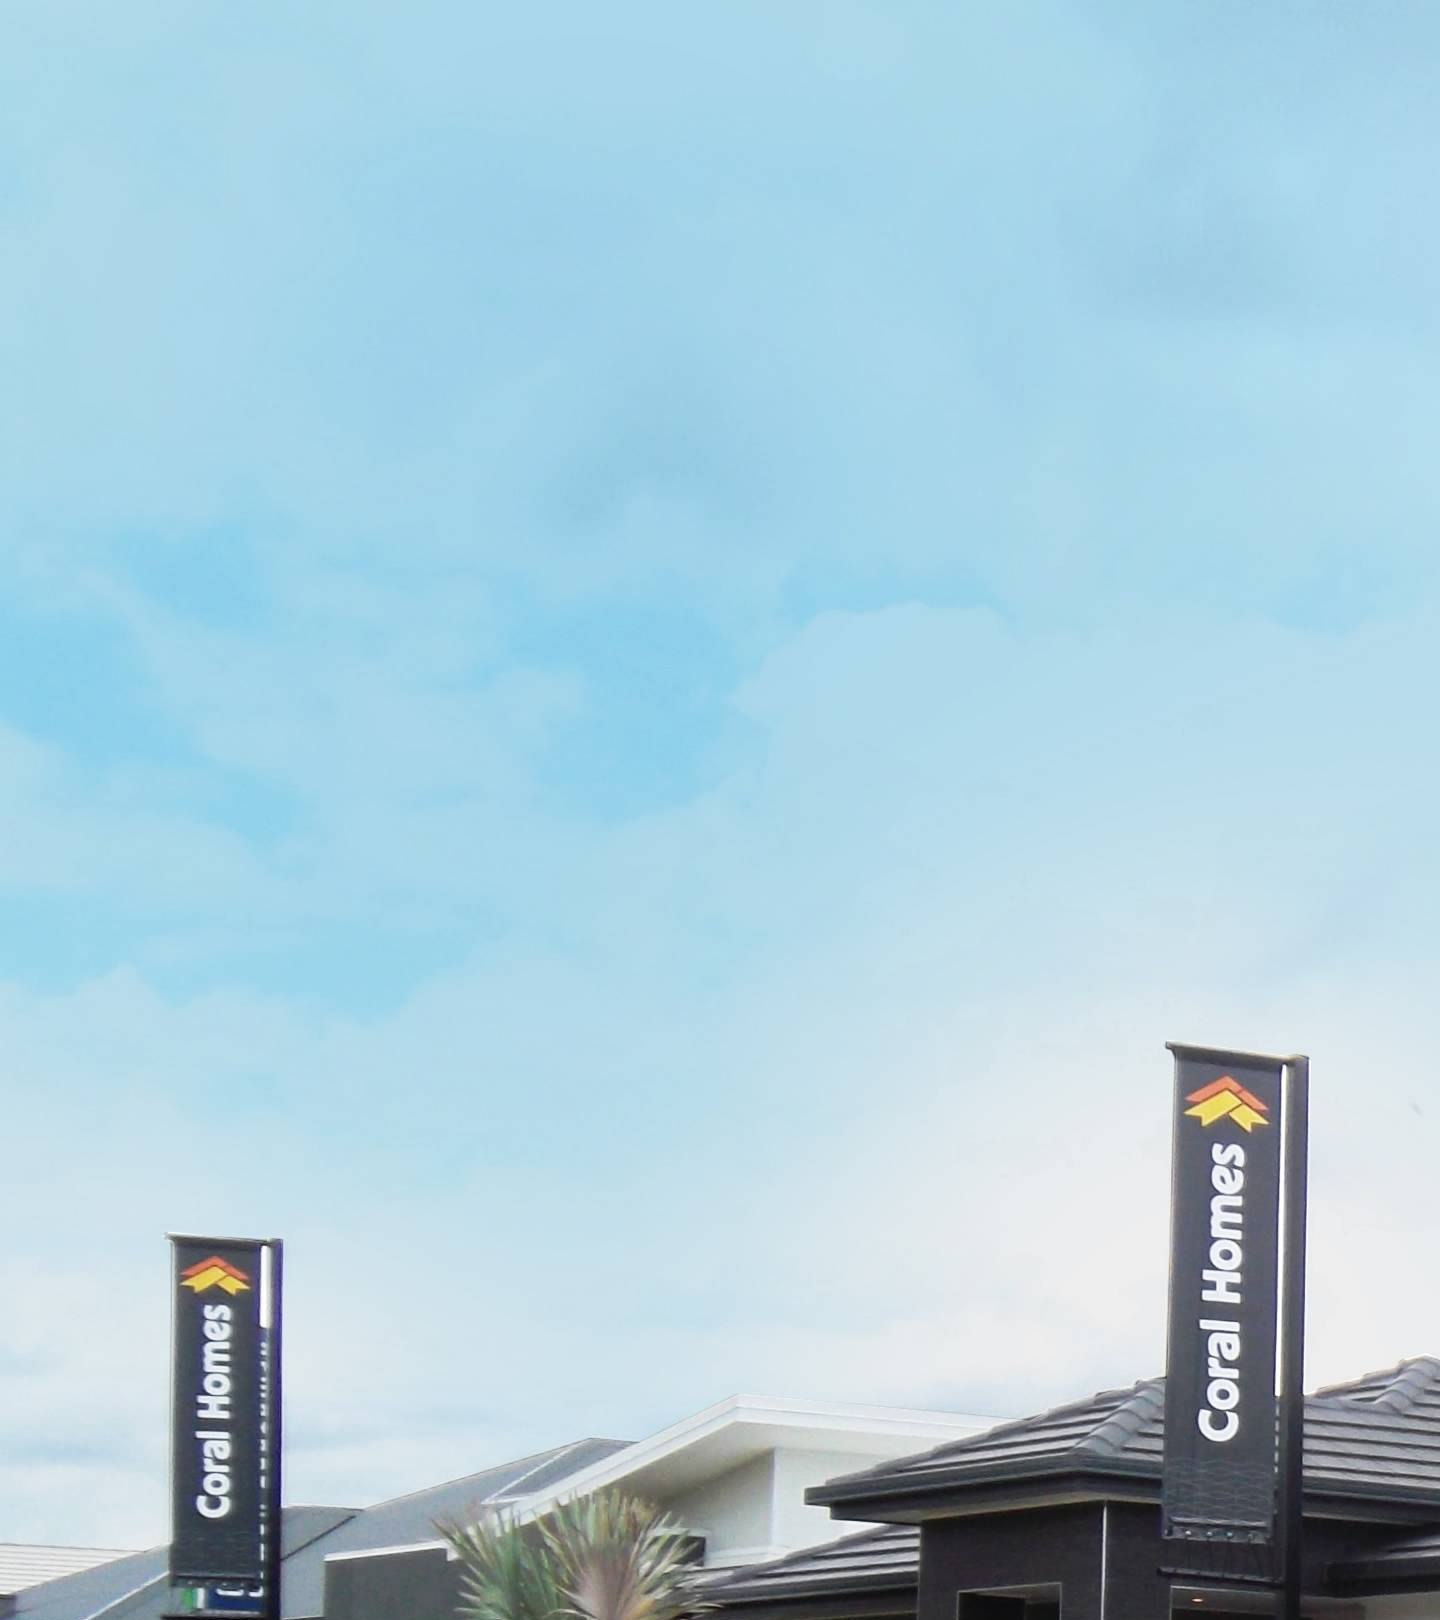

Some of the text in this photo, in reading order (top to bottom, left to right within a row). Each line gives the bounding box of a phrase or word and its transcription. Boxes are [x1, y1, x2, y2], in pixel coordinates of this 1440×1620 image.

[194, 1303, 233, 1519] Coral Homes
[1197, 1142, 1246, 1444] Coral Homes
